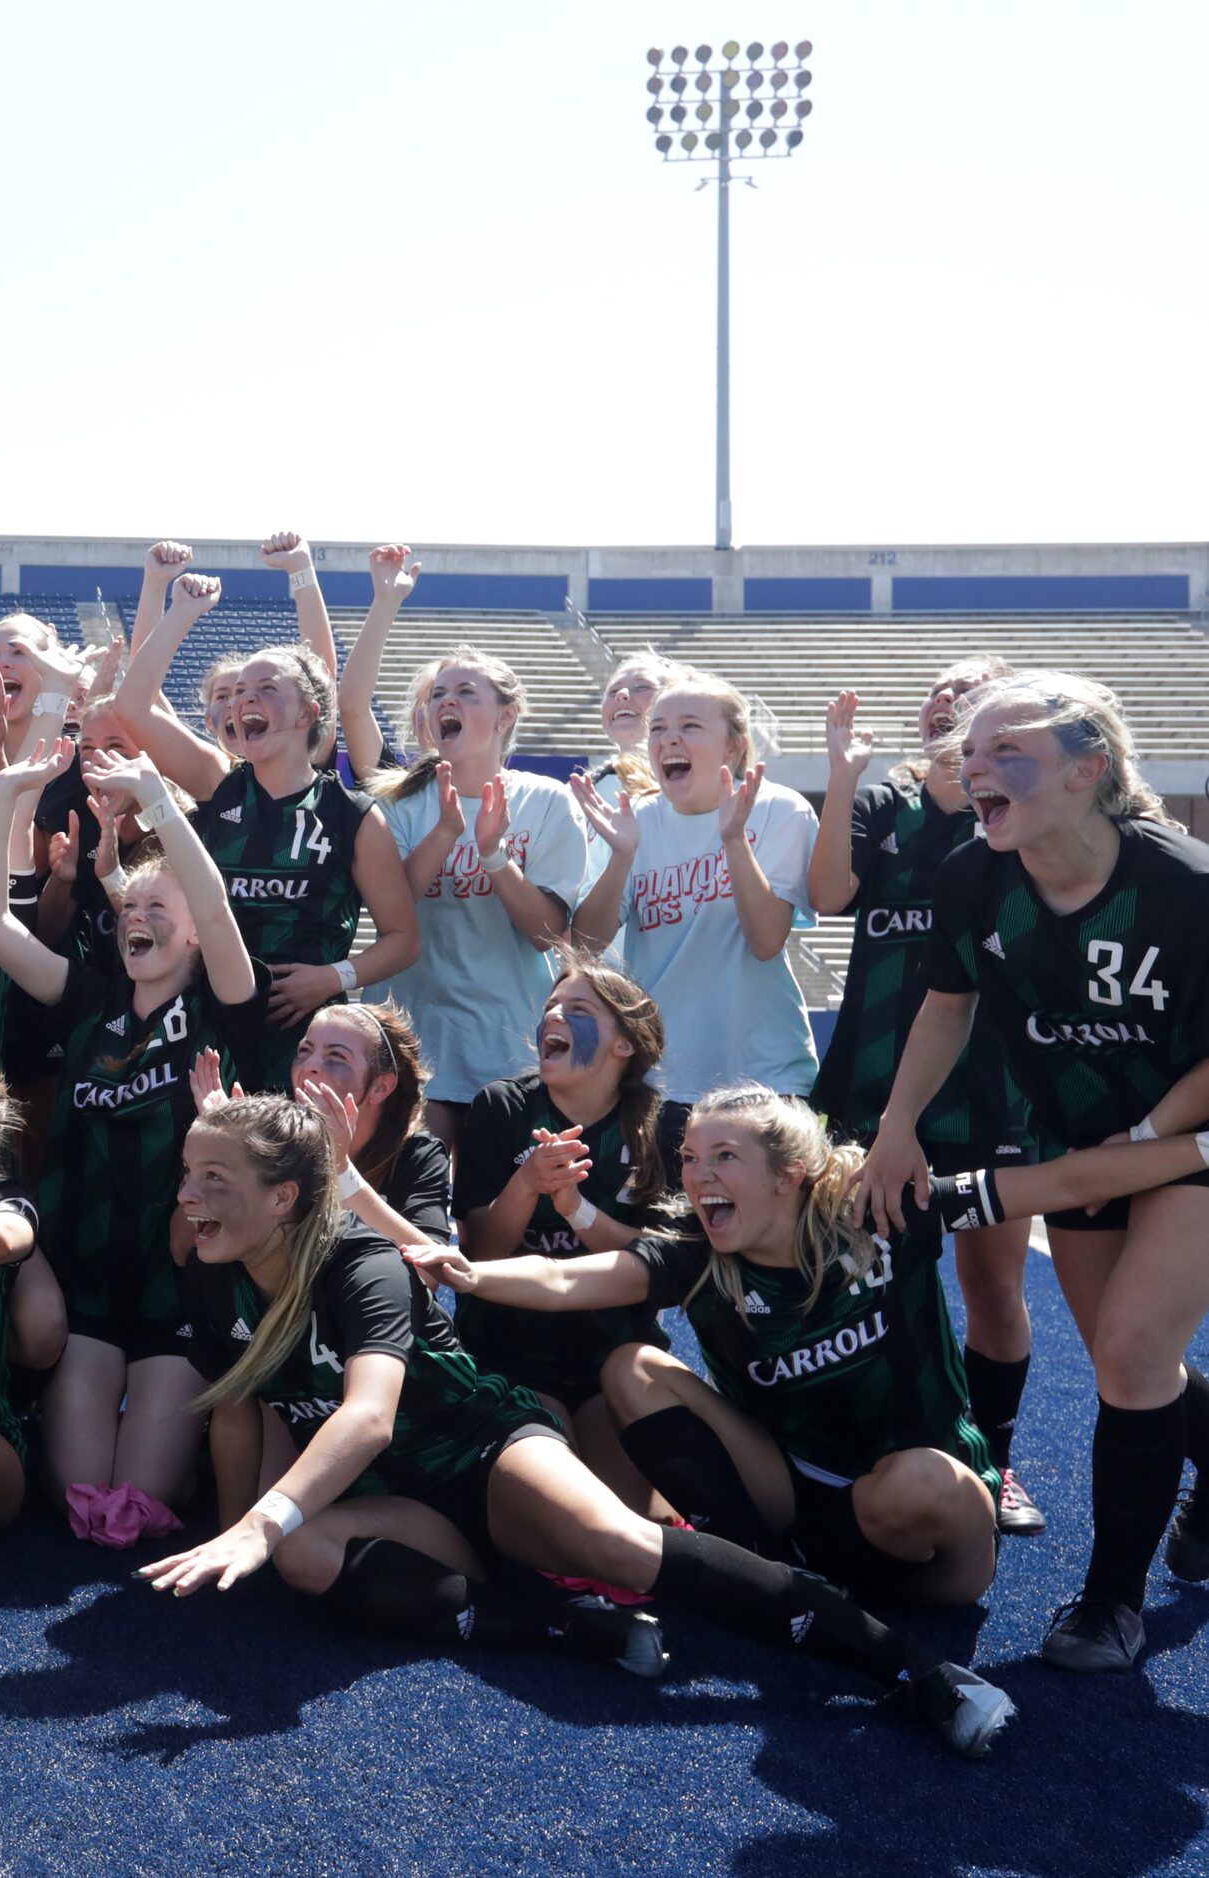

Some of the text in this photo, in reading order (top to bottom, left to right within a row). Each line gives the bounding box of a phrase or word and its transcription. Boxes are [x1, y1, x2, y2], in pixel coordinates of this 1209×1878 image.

[869, 551, 896, 565] 212
[290, 809, 332, 865] 14
[225, 877, 310, 900] RROLL
[1087, 939, 1170, 1011] 34
[73, 1062, 179, 1109] CARROLL
[747, 1311, 889, 1386] CARROLL
